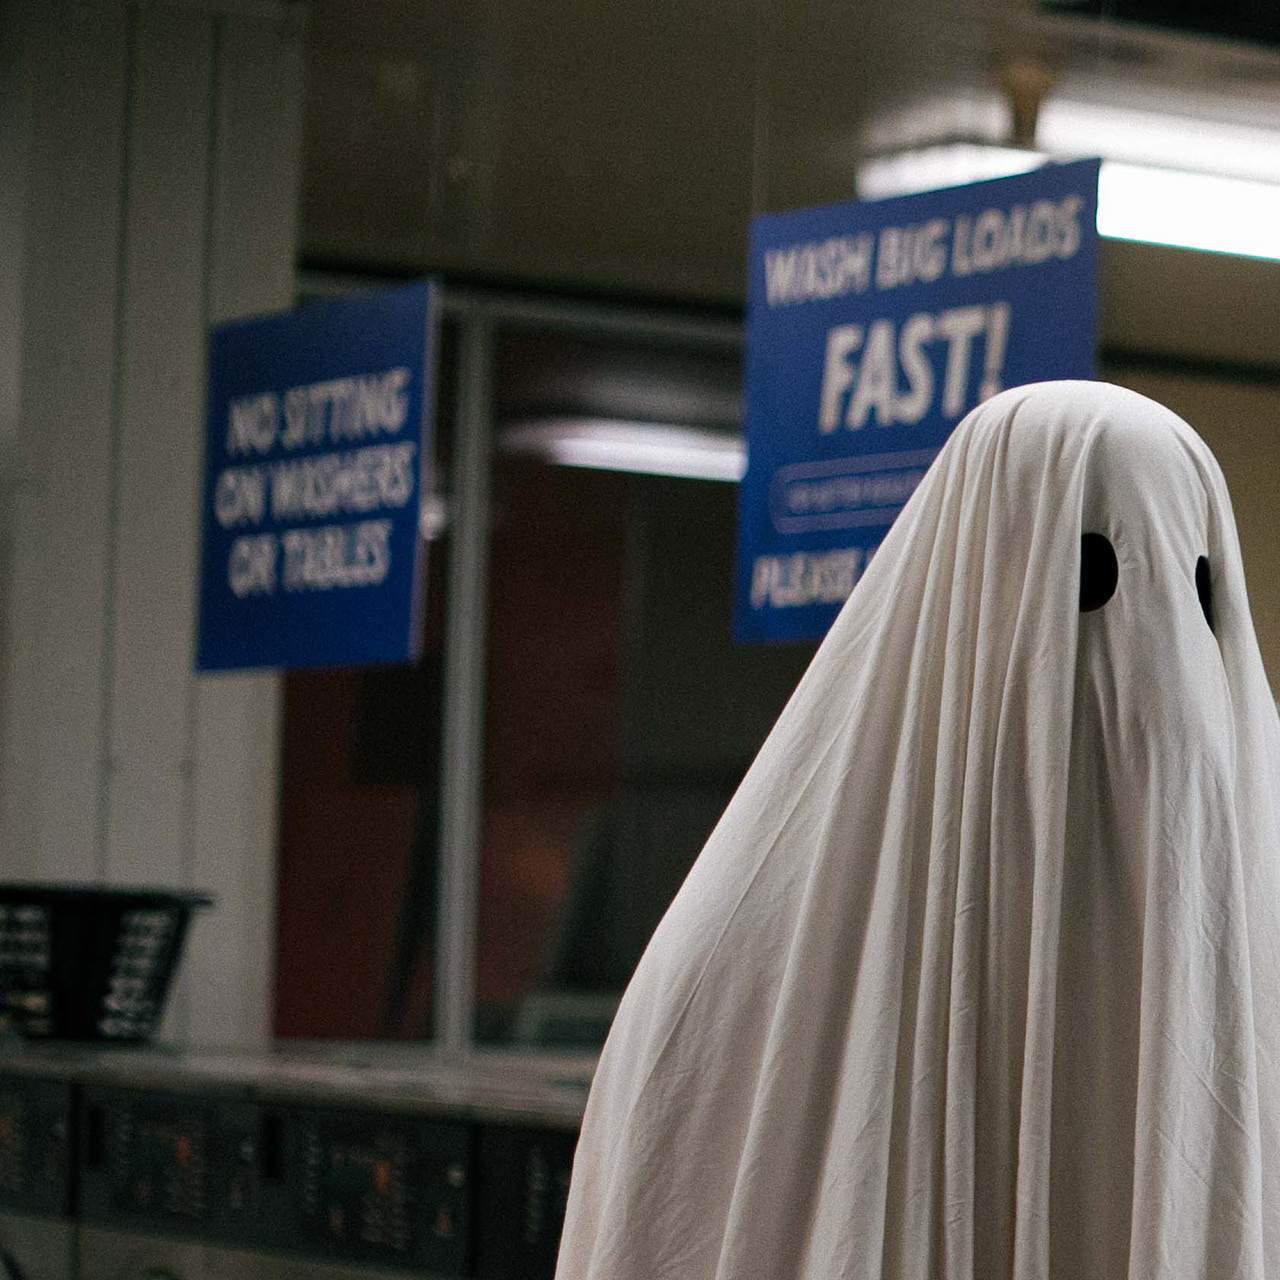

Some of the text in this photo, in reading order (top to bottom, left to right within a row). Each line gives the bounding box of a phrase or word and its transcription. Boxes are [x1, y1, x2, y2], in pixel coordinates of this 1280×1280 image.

[764, 195, 1084, 309] WASH BIG LOADS
[227, 367, 411, 454] NO SITTING
[818, 300, 1012, 435] FAST!
[215, 463, 266, 529] ON
